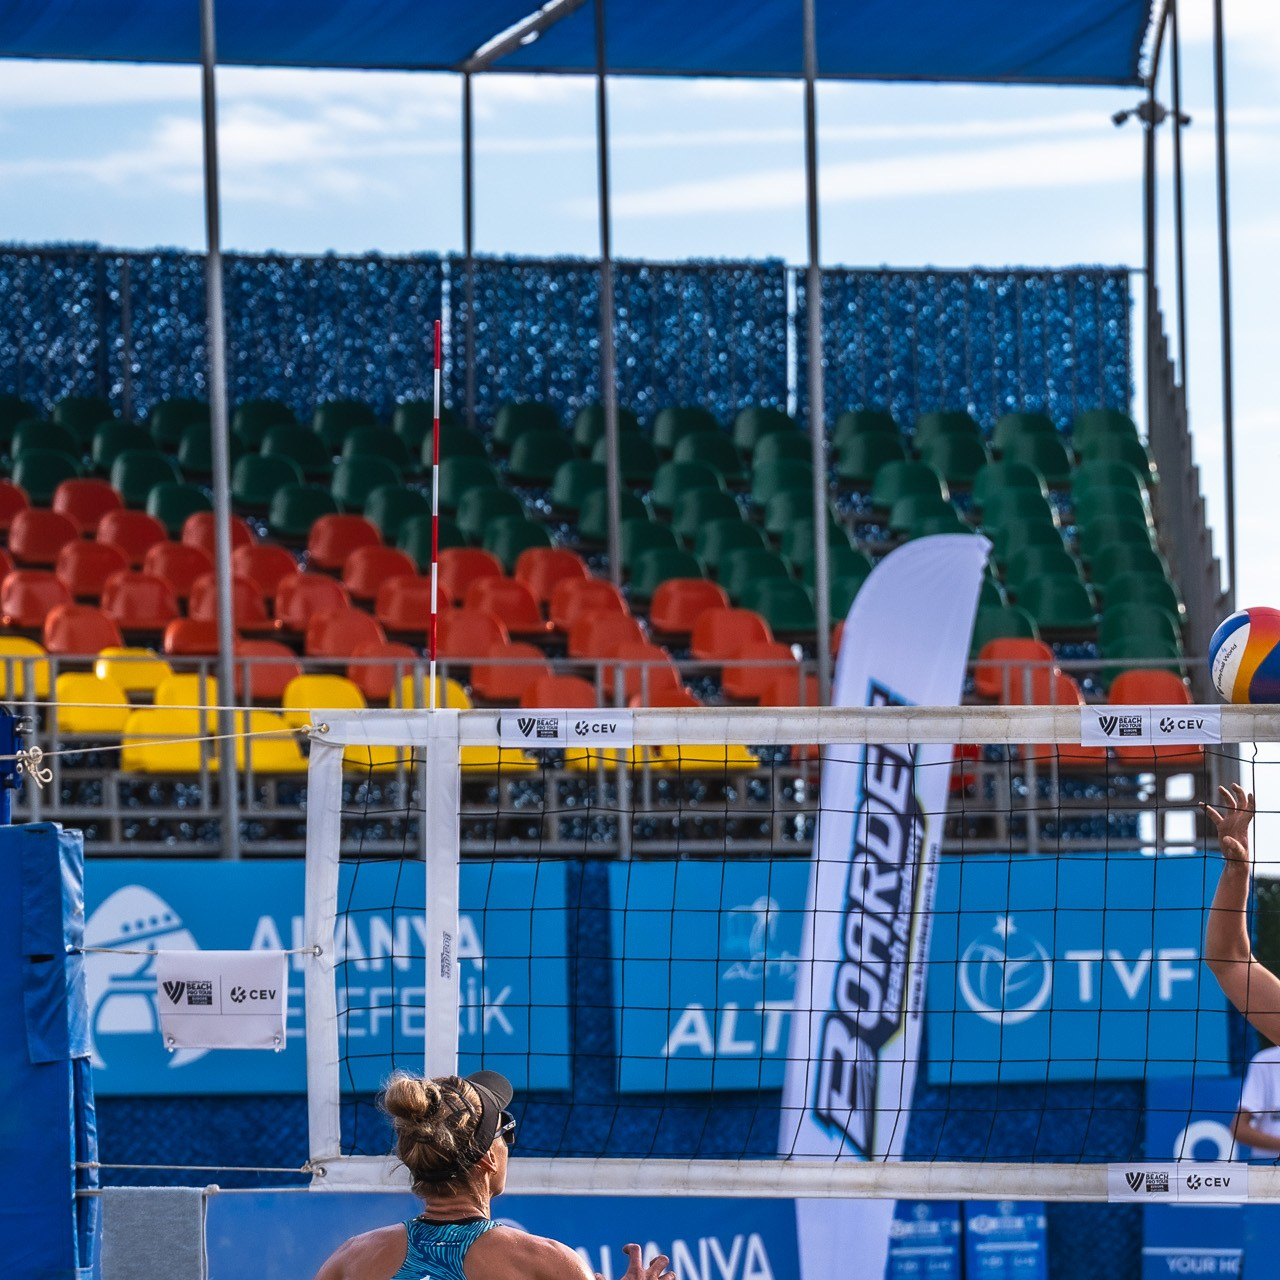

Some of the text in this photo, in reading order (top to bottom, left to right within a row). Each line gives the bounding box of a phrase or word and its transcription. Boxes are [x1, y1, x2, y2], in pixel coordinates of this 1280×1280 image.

[591, 723, 617, 733] CEV
[1177, 719, 1204, 729] CEV
[1065, 948, 1197, 1002] TVF
[249, 989, 276, 1000] CEV
[1204, 1177, 1231, 1187] CEV
